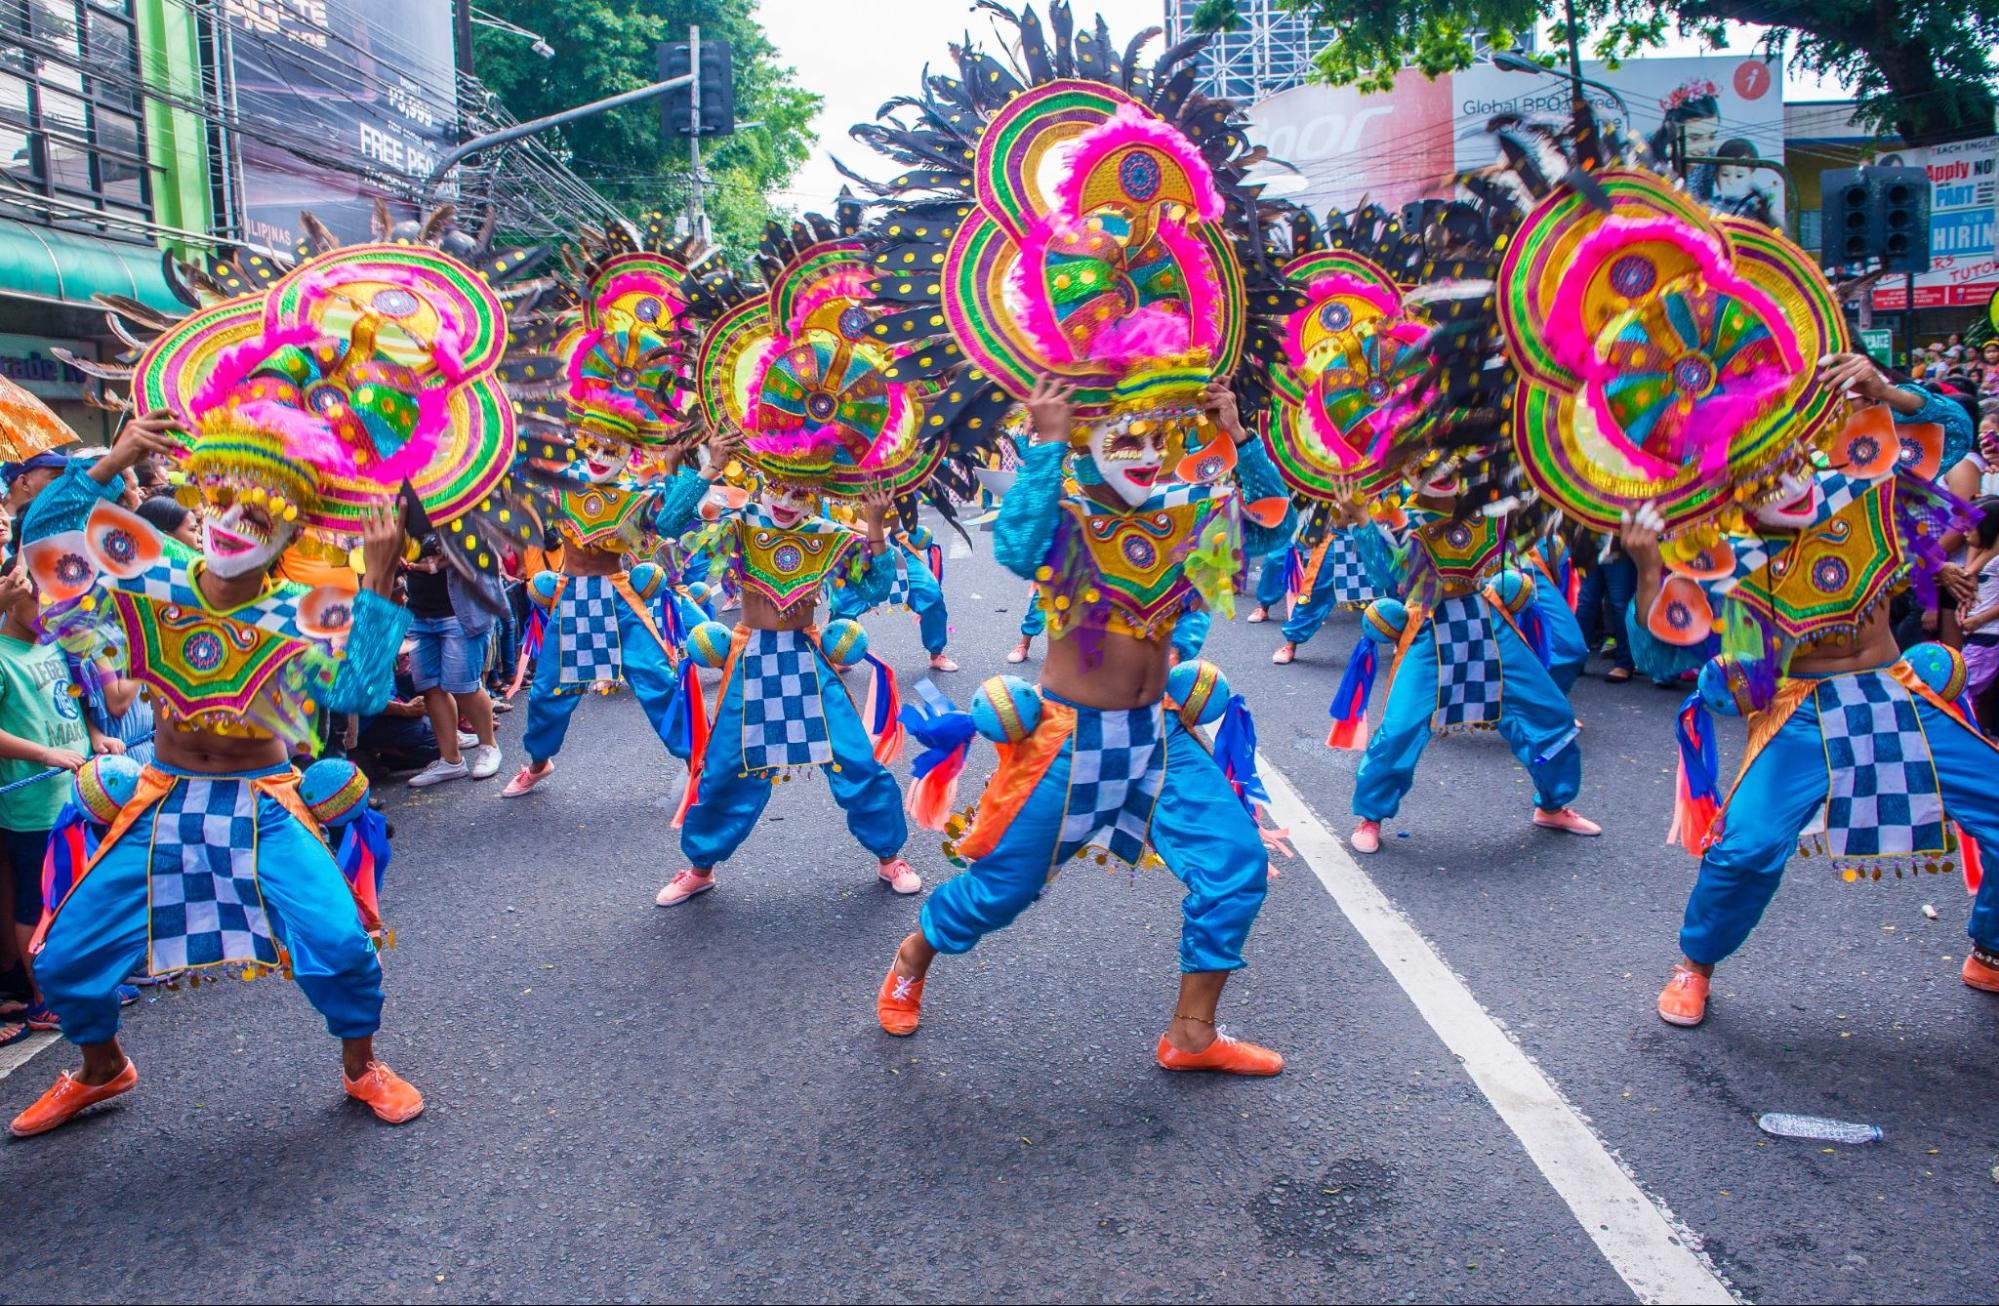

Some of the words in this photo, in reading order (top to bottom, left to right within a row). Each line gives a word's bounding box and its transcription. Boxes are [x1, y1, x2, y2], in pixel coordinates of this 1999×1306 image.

[1463, 99, 1518, 115] Global
[1523, 97, 1562, 113] BPO
[360, 121, 405, 173] FREE
[1931, 145, 1961, 156] TEACH
[1925, 160, 1970, 183] Apply
[1974, 158, 1996, 176] NO
[1936, 184, 1974, 207] PART
[247, 218, 291, 246] ILIPINAS
[1933, 222, 1996, 251] HIRIN
[1950, 261, 1999, 282] TUTO
[0, 351, 58, 380] rade
[26, 659, 68, 691] LEGE
